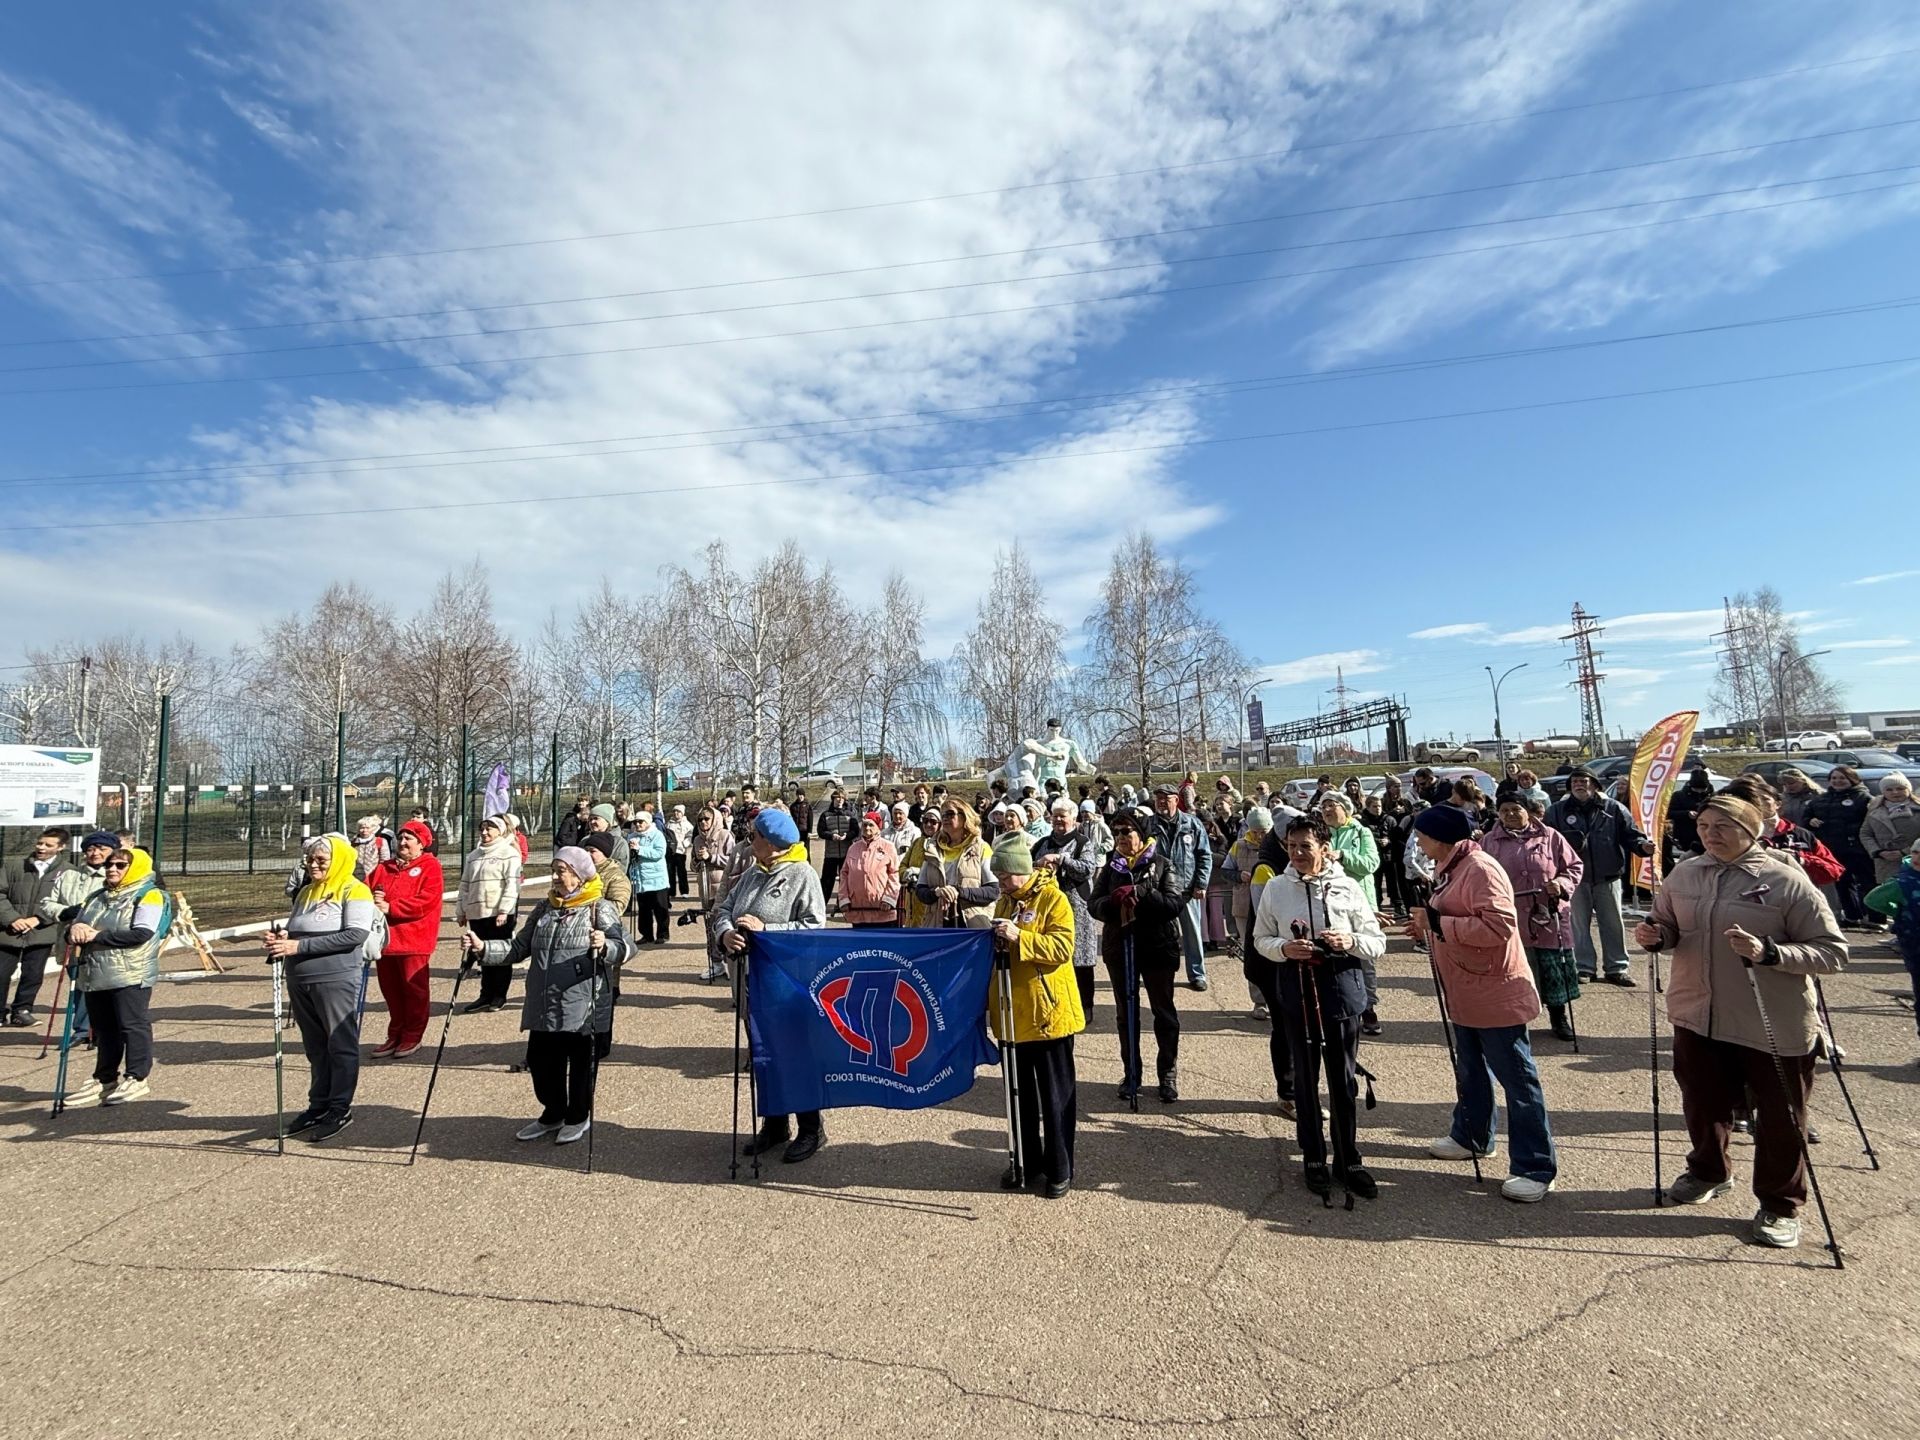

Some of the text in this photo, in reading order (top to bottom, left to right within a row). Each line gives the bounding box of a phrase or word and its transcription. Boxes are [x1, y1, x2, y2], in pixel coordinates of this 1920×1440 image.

[846, 949, 913, 969] ОБЩЕСТВЕННАЯ
[912, 969, 946, 1031] ОРГАНИЗАЦИЯ
[825, 1065, 955, 1094] СОЮЗ ПЕНСИОНЕРОВ РОССИИ
